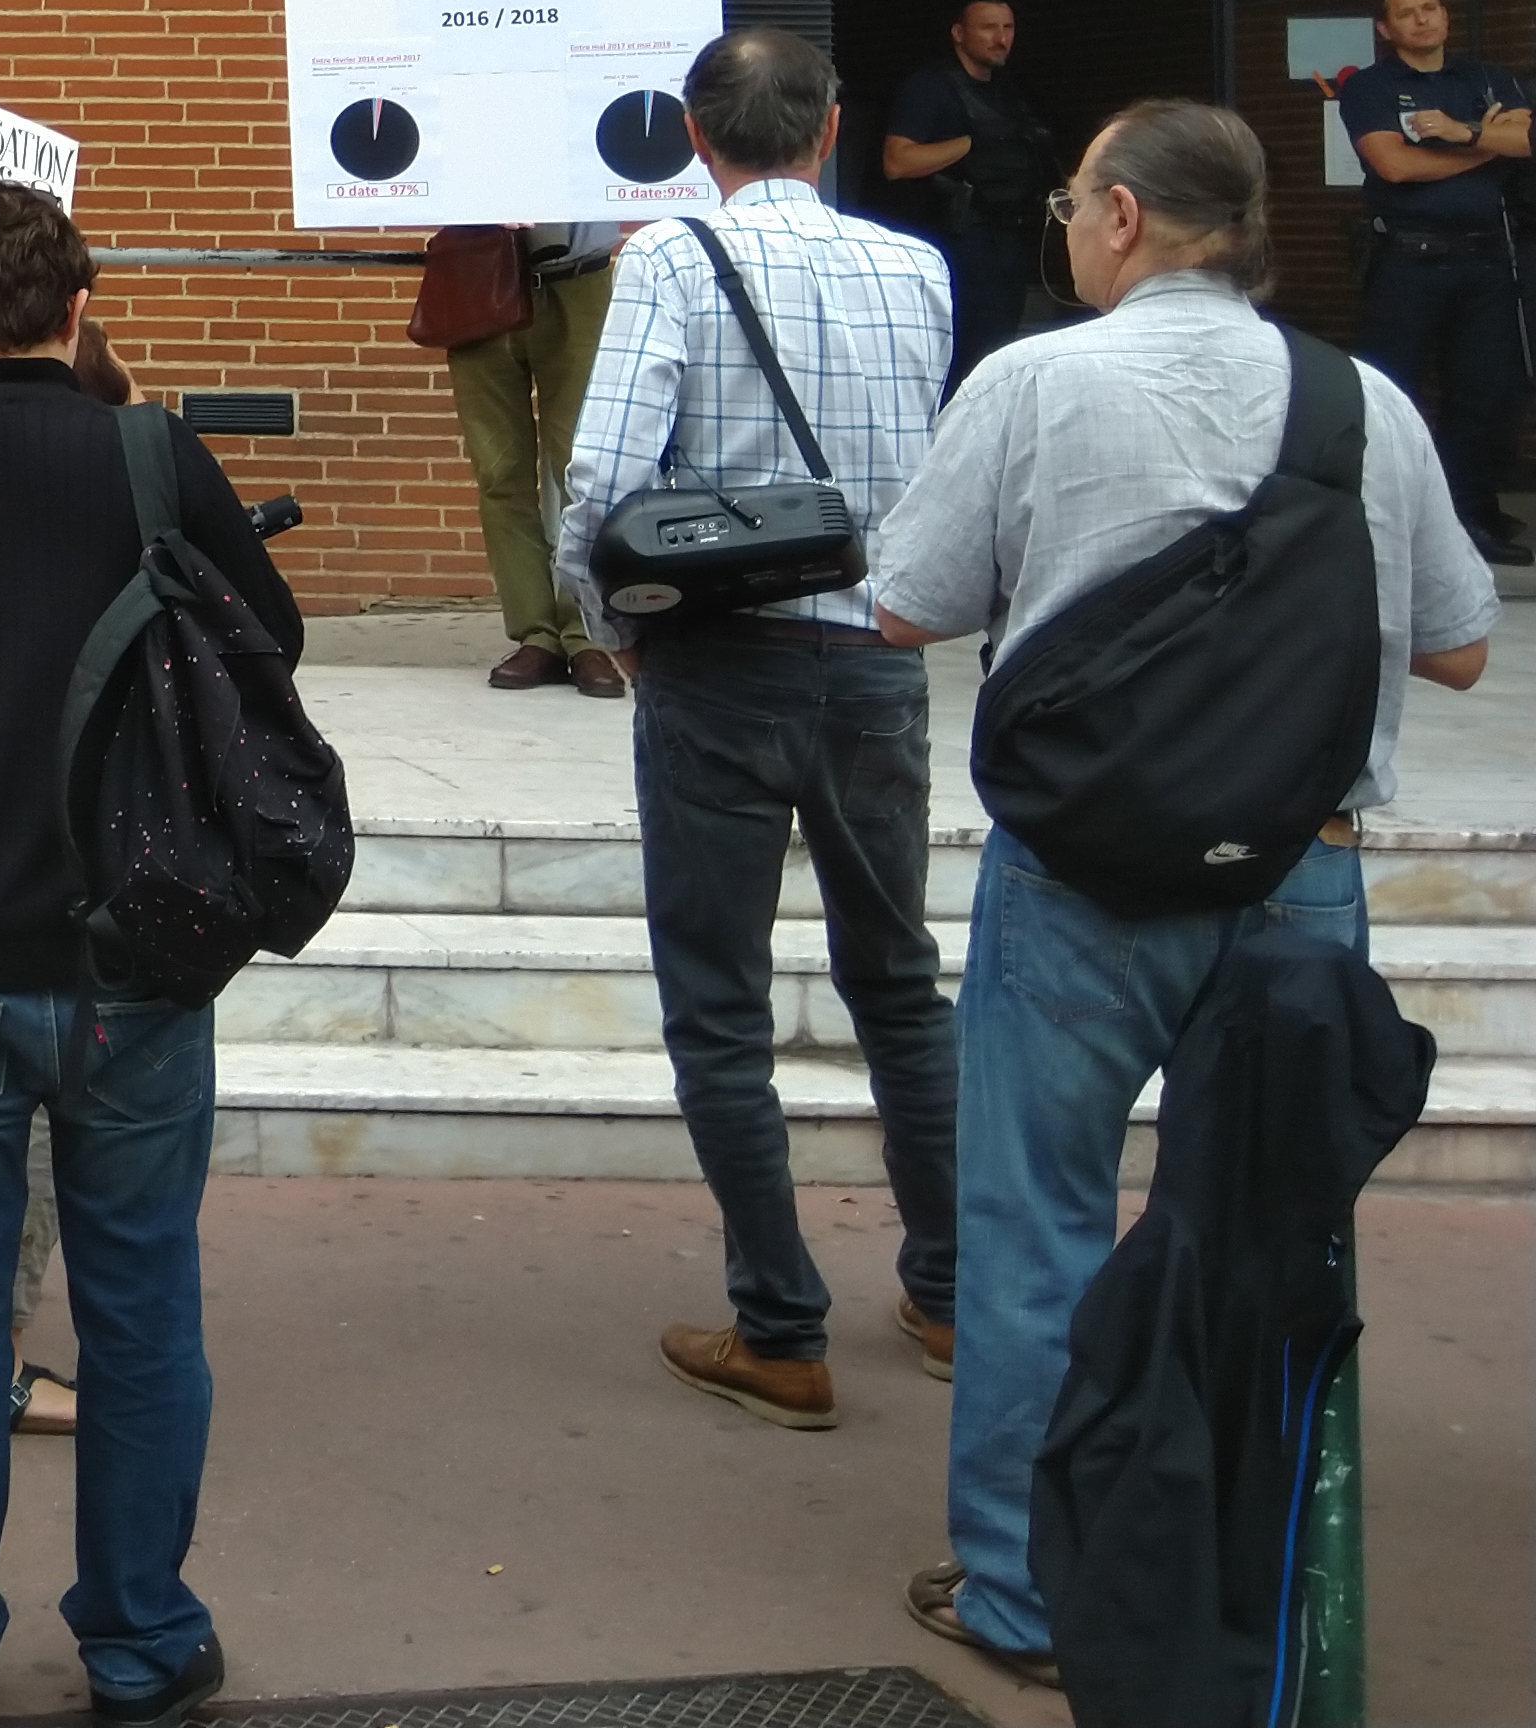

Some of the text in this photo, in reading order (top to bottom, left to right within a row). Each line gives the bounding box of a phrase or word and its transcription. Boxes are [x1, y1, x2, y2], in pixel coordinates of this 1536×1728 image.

[441, 7, 559, 29] 2016 / 2018
[336, 184, 419, 197] 0 date 97%
[617, 188, 627, 199] 0
